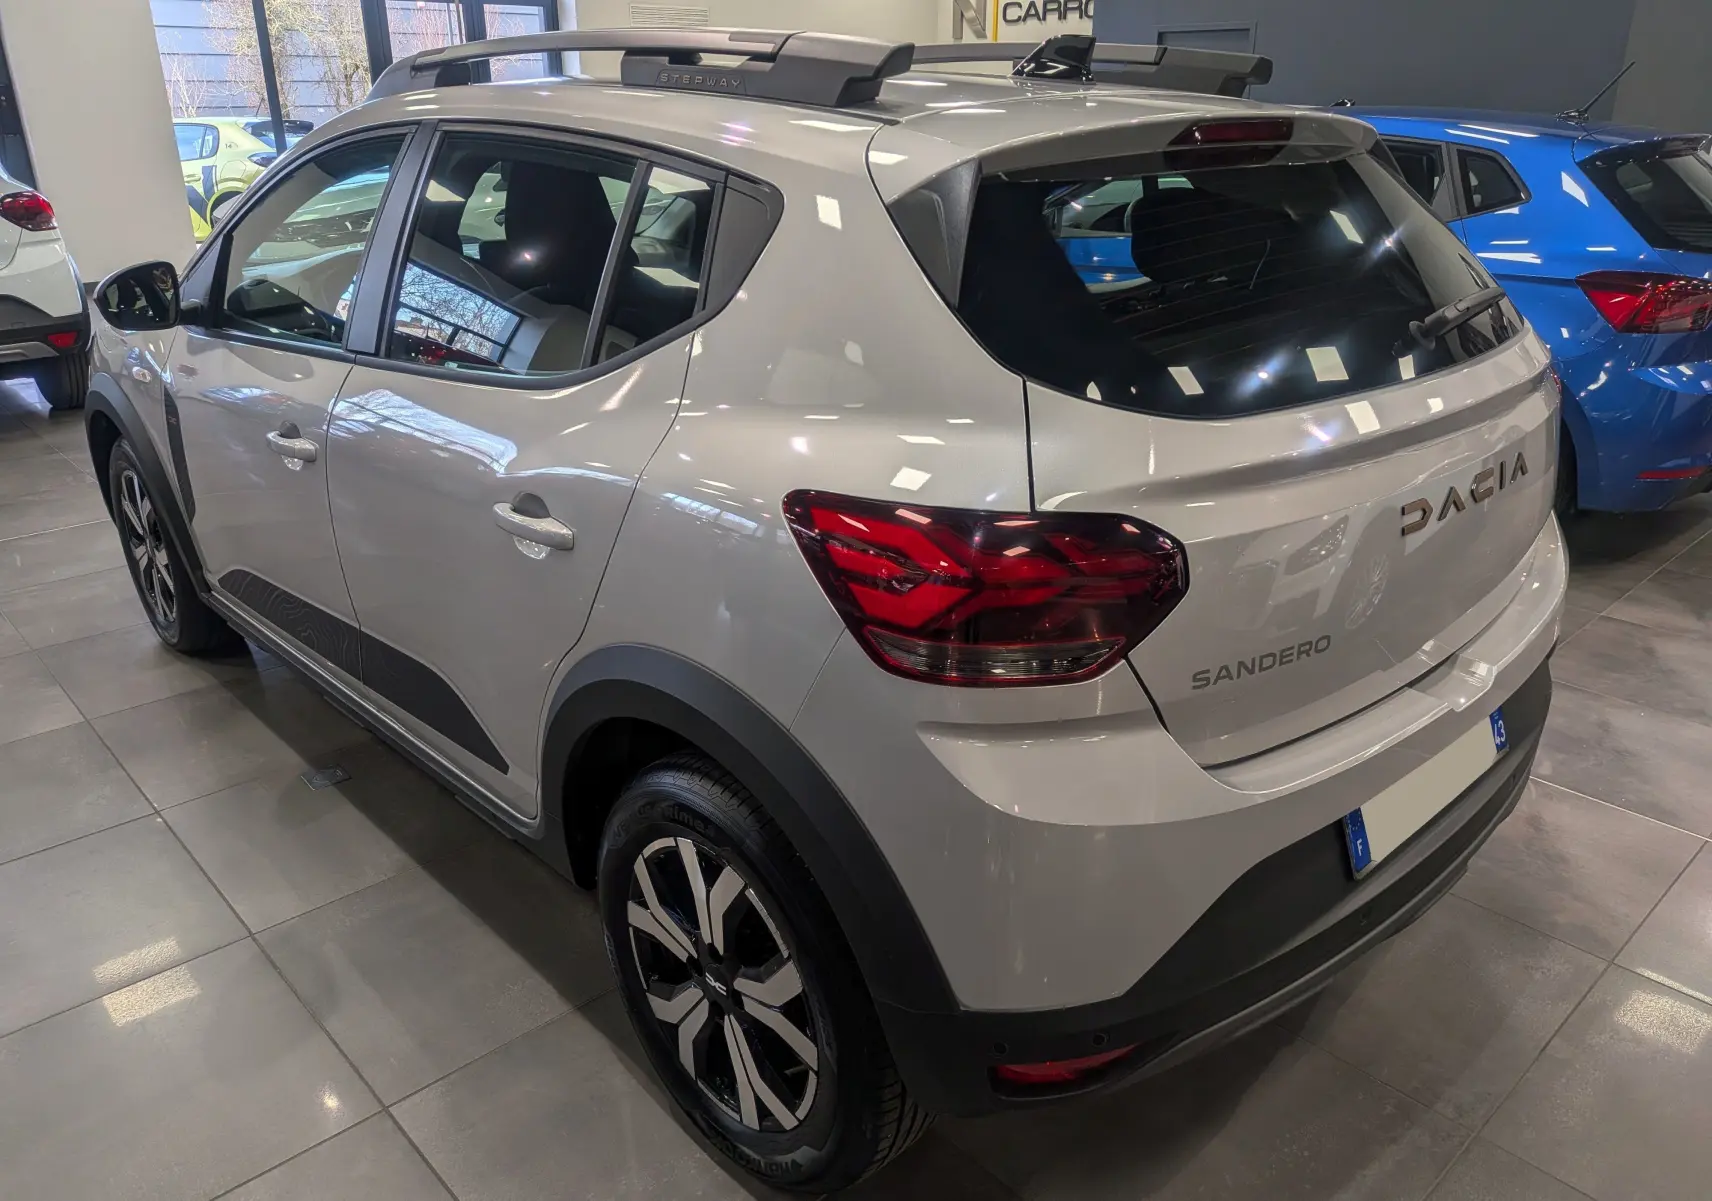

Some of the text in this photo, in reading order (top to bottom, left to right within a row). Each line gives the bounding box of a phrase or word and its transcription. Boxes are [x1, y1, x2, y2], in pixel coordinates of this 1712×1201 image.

[660, 73, 741, 88] STEPWAY
[1401, 452, 1528, 537] DACIA
[1191, 634, 1331, 690] SANDERO
[1494, 719, 1506, 745] 43
[1356, 838, 1363, 857] F
